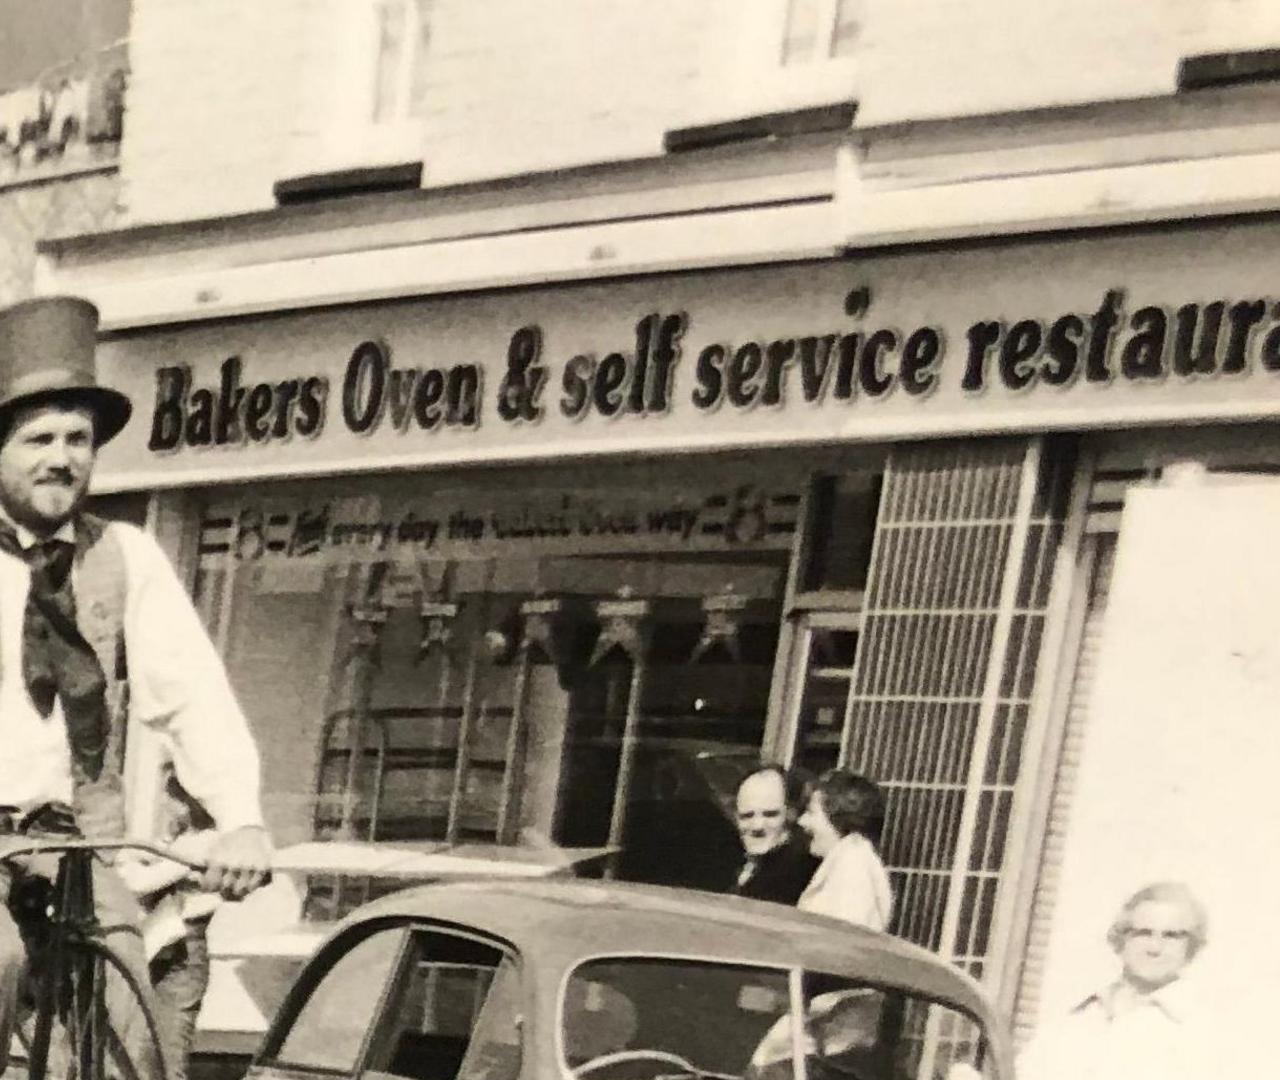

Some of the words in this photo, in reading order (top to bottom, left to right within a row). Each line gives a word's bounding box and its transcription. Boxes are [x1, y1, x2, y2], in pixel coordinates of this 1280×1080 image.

[148, 354, 330, 453] Bakers
[342, 338, 485, 437] Oven
[496, 324, 548, 423] &
[560, 310, 688, 422] self
[692, 284, 942, 412] service
